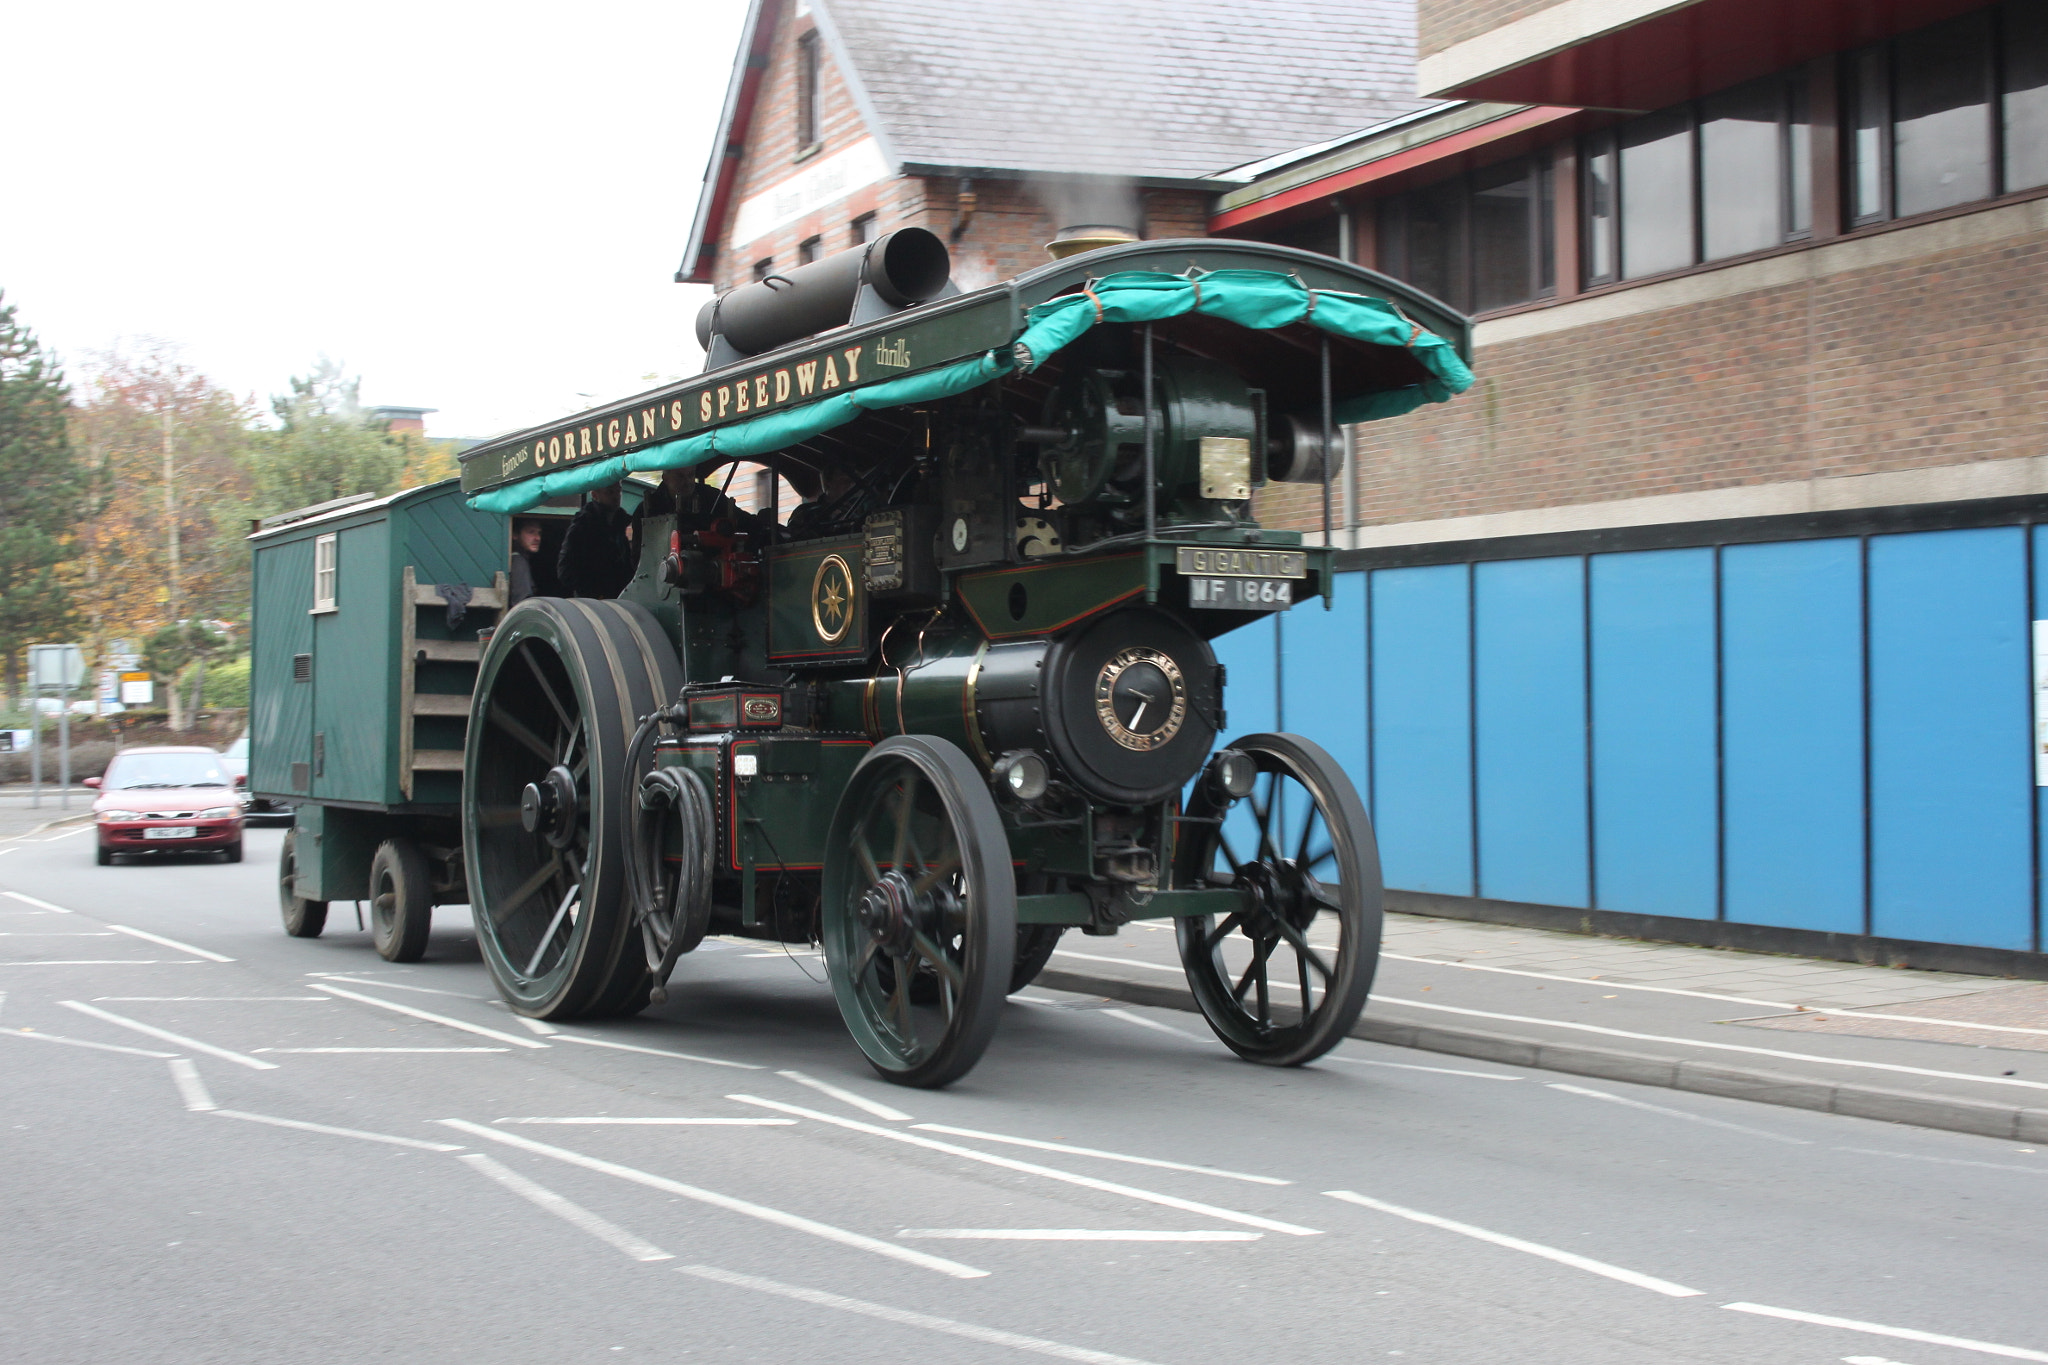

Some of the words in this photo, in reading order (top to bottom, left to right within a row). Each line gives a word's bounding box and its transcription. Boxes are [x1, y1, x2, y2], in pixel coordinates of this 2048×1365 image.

[502, 446, 529, 477] famous
[534, 400, 683, 468] CORRIGAN'S
[700, 345, 863, 423] SPEEDWAY
[876, 336, 911, 368] thrills
[1193, 551, 1293, 574] GIGANTIC
[1192, 579, 1226, 601] WF
[1235, 580, 1291, 604] 1864
